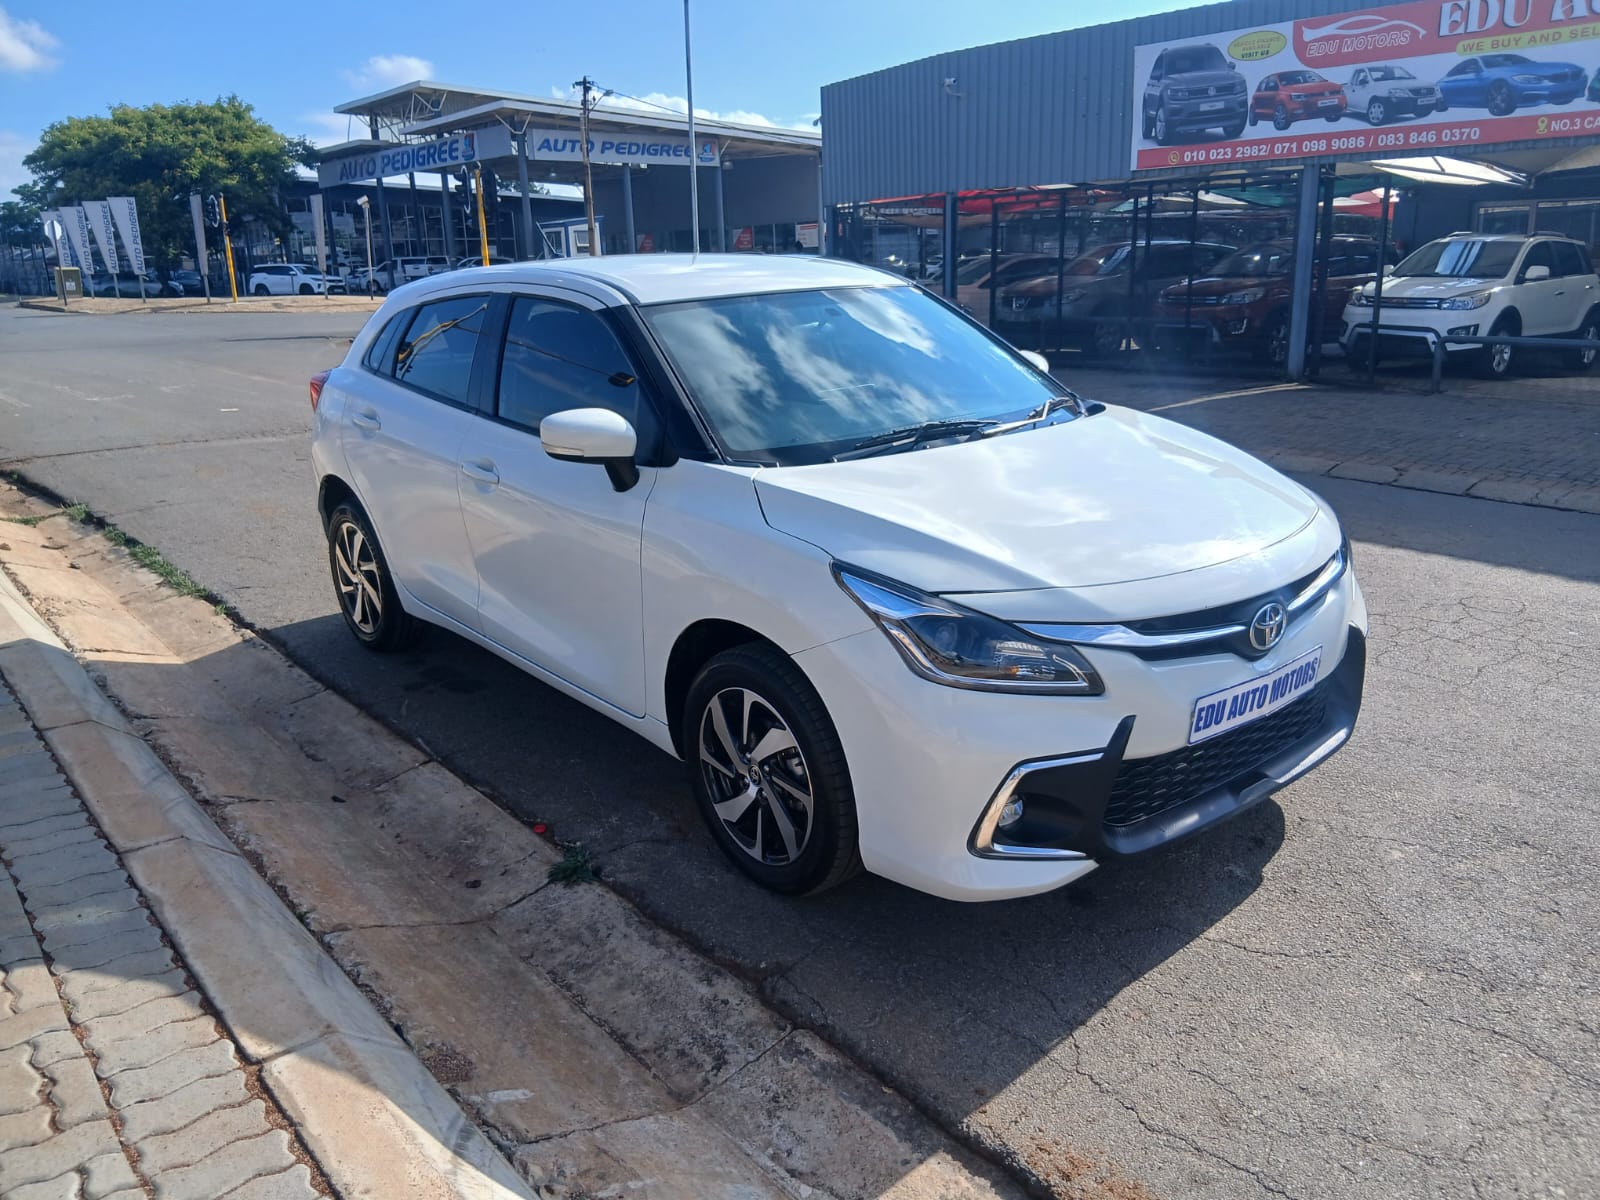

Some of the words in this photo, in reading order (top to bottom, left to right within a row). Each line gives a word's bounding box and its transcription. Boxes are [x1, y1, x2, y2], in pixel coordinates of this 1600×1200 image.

[1438, 0, 1532, 38] EDU
[1306, 39, 1339, 57] EDU
[1341, 30, 1411, 53] MOTORS
[1462, 41, 1485, 53] WE
[1491, 36, 1522, 49] BUY
[1528, 31, 1562, 44] AND
[1550, 118, 1581, 131] NO.3
[339, 158, 377, 181] AUTO
[380, 138, 460, 174] PEDIGREE
[1184, 151, 1206, 162] 010
[1209, 148, 1232, 160] 023
[1236, 144, 1271, 157] 2982/
[1274, 142, 1297, 154] 071
[1302, 139, 1327, 152] 098
[1331, 136, 1365, 150] 9086
[1378, 133, 1404, 146] 083
[1409, 131, 1437, 144] 846
[1442, 127, 1480, 140] 0370
[76, 208, 88, 249] PEDIGREE
[101, 202, 113, 246] PEDIGREE
[126, 199, 140, 245] PEDIGREE
[83, 251, 92, 272] AUTO
[108, 248, 118, 271] AUTO
[134, 248, 144, 273] AUTO
[1194, 697, 1227, 733] EDU
[1227, 683, 1269, 721] AUTO
[1268, 656, 1318, 705] MOTORS
